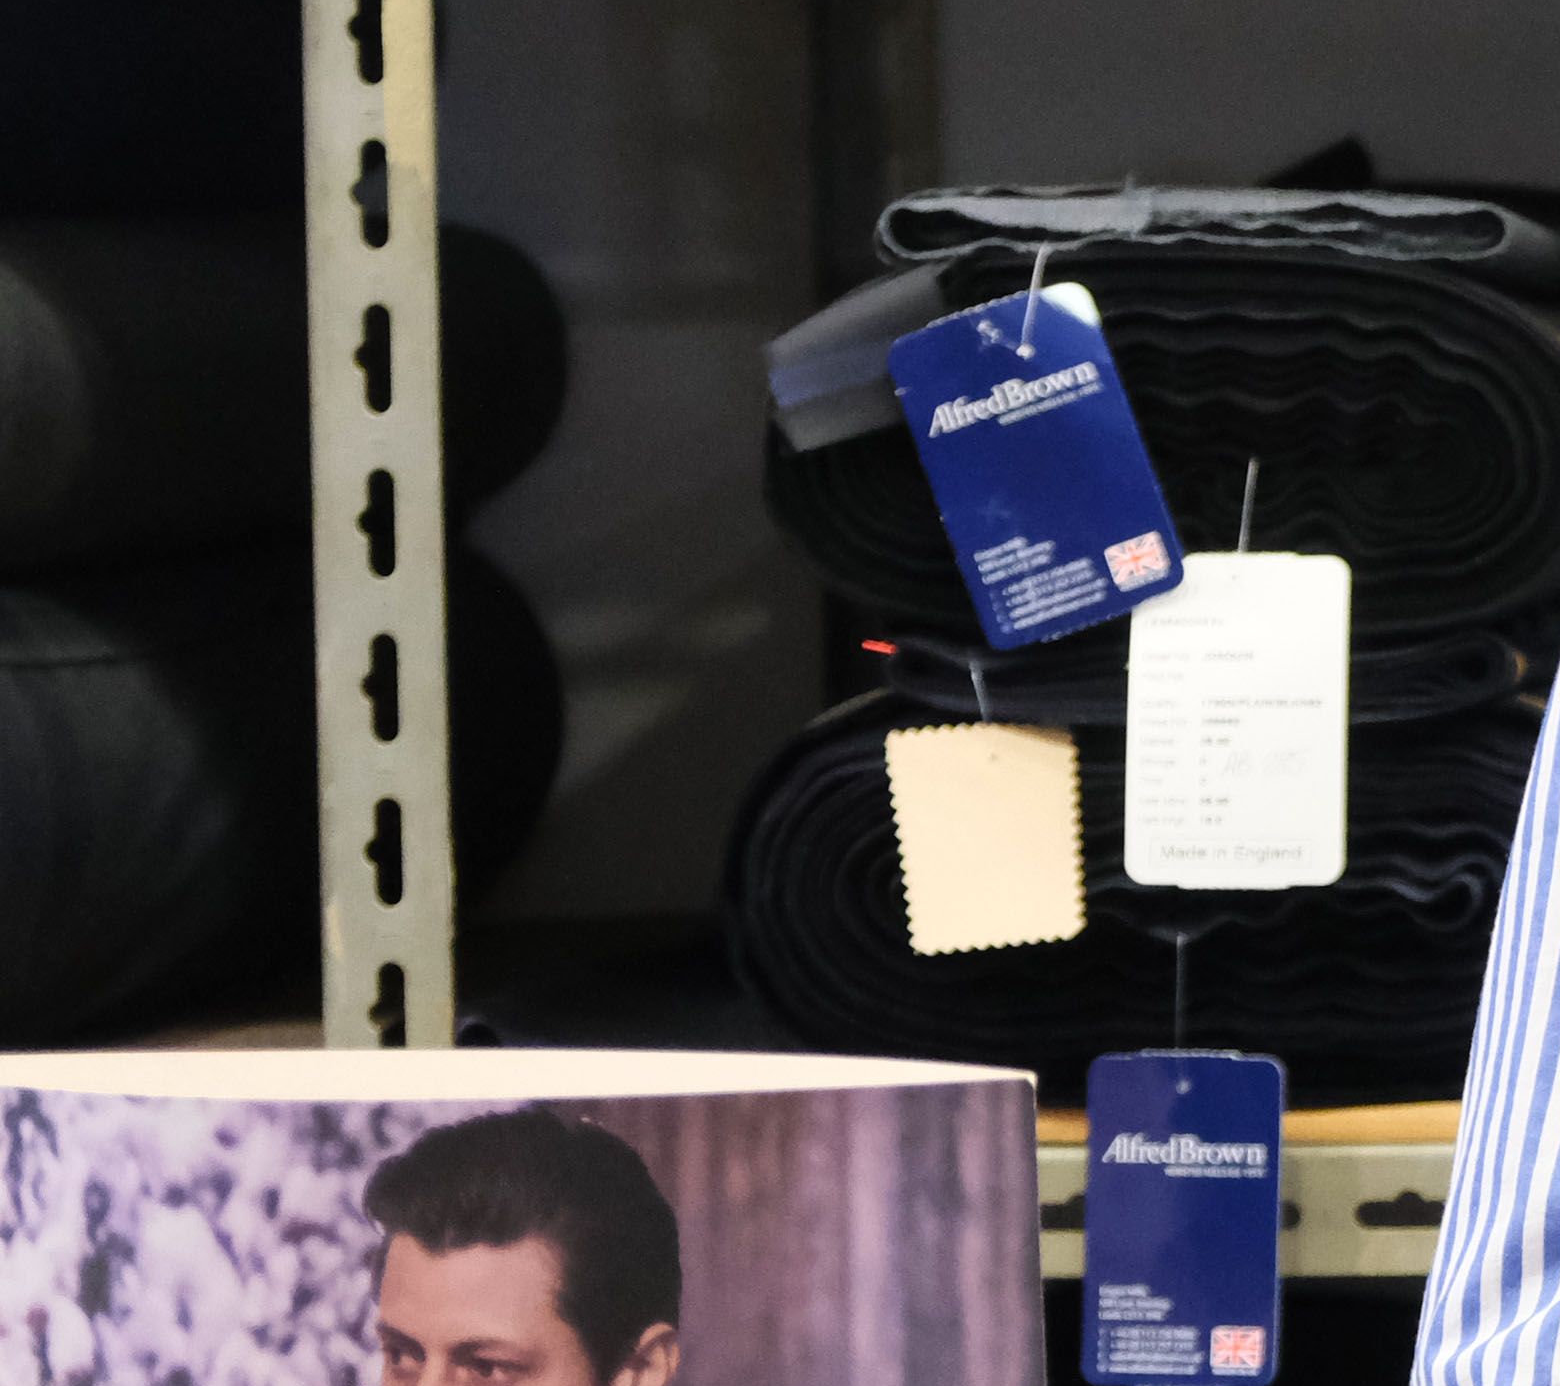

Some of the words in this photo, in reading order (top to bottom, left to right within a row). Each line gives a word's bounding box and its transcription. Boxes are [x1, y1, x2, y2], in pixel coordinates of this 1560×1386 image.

[1160, 845, 1207, 861] Made
[1214, 845, 1227, 861] in
[1234, 844, 1302, 864] England
